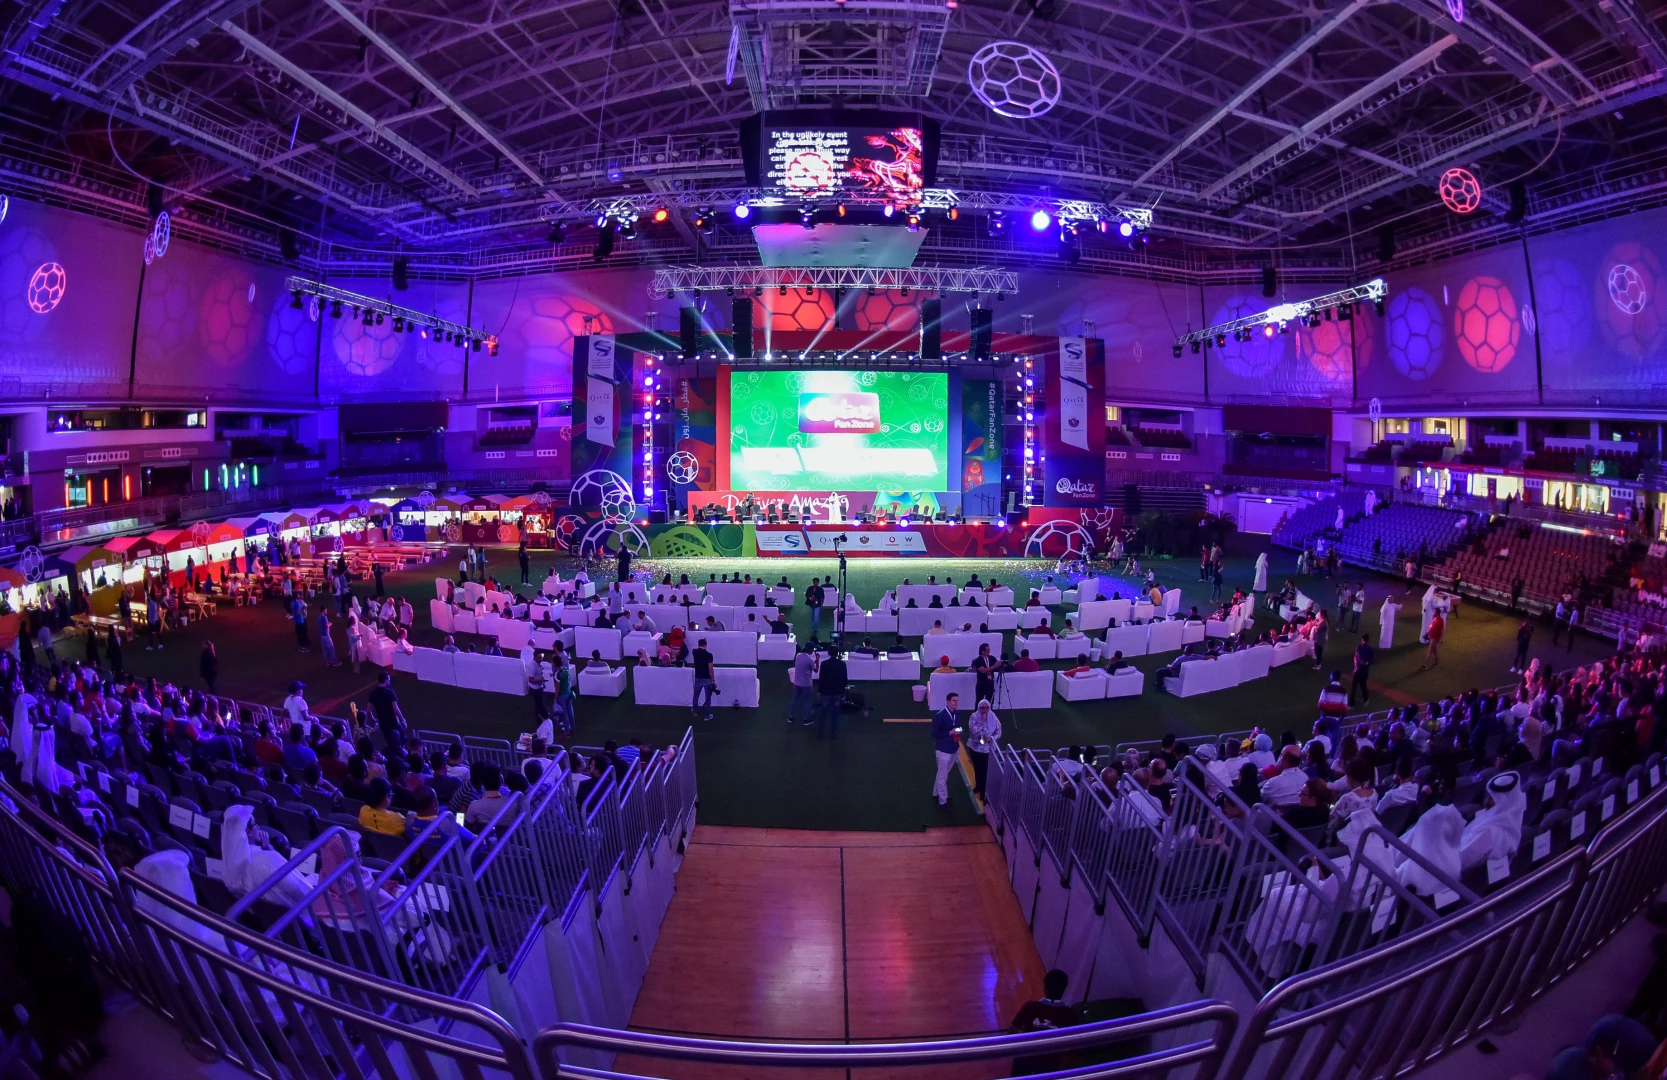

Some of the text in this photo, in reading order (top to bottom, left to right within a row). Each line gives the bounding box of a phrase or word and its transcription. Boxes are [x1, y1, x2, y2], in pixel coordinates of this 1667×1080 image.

[782, 131, 795, 139] the
[796, 131, 825, 140] unlikely
[826, 131, 848, 139] event
[1056, 477, 1096, 494] Qatar
